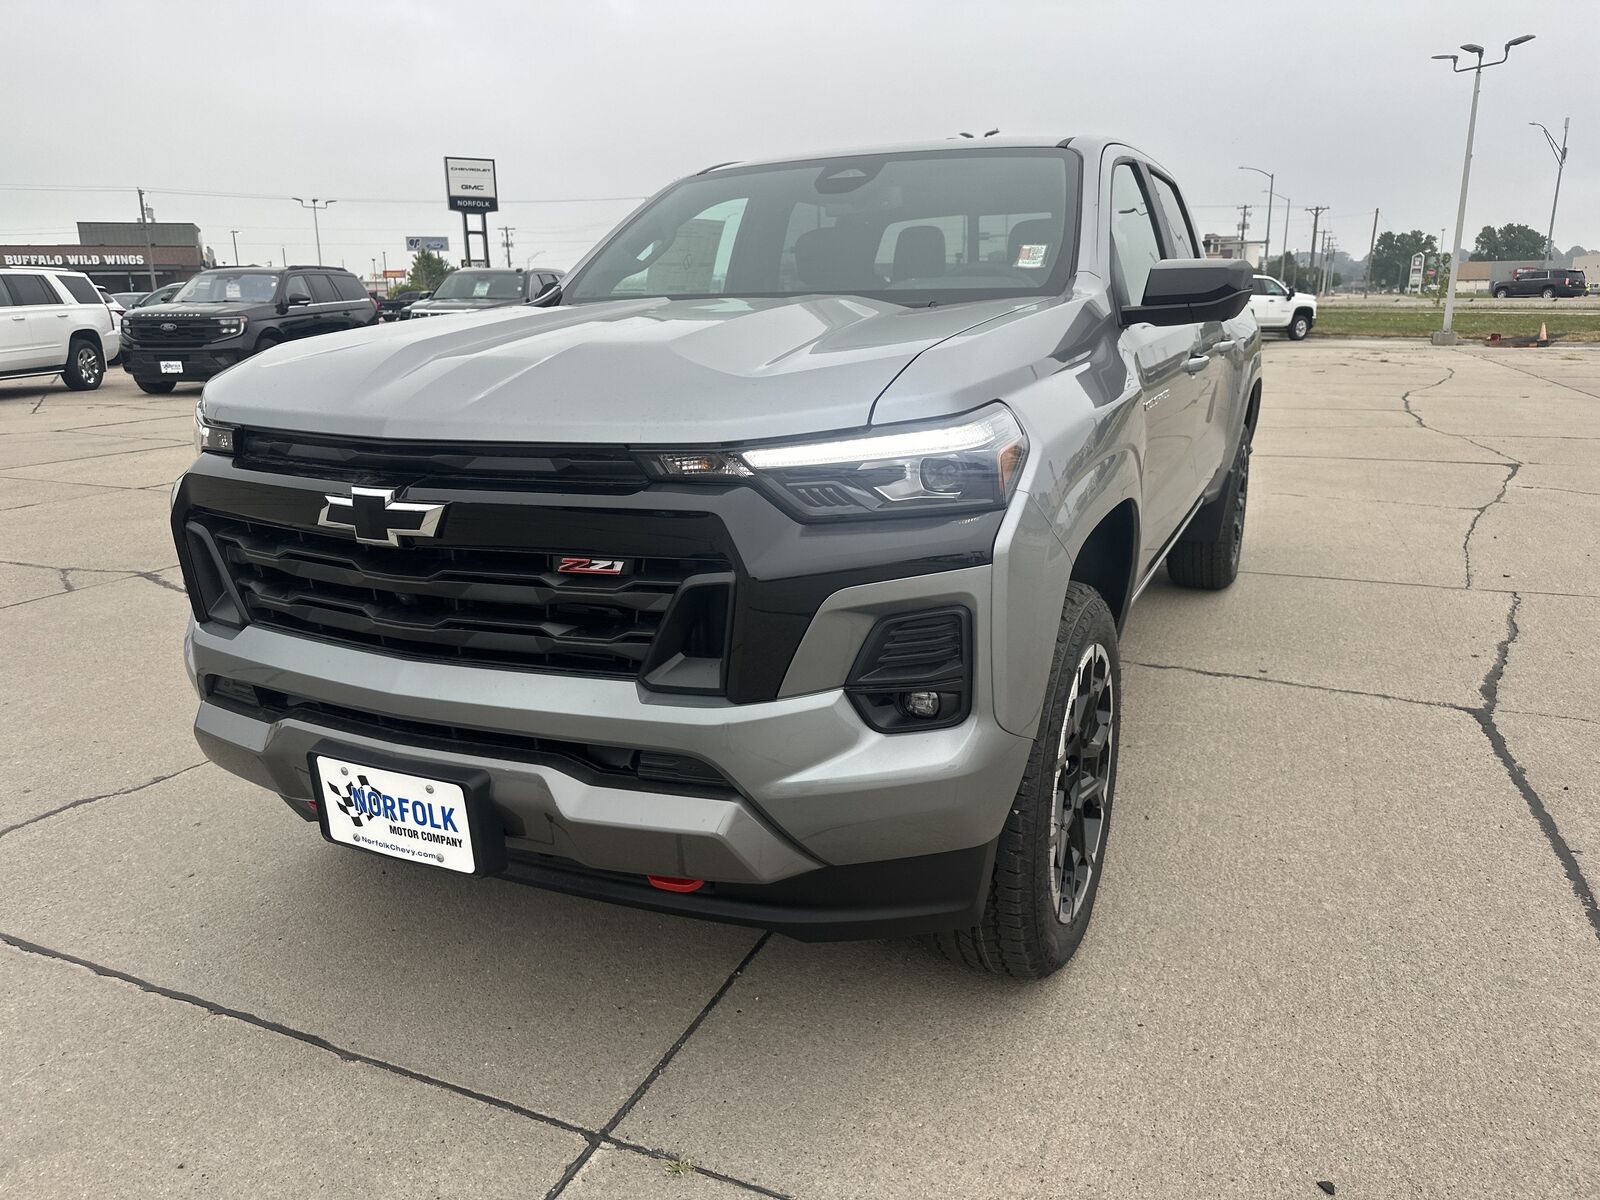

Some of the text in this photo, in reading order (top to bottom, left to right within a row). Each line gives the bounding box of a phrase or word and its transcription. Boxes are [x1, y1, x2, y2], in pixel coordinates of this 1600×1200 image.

[4, 255, 145, 265] BUFFALO WILD WINGS
[352, 787, 459, 833] NORFOLK
[361, 835, 436, 860] NorfolkChevy.com
[389, 825, 463, 848] MOTOR COMPANY
